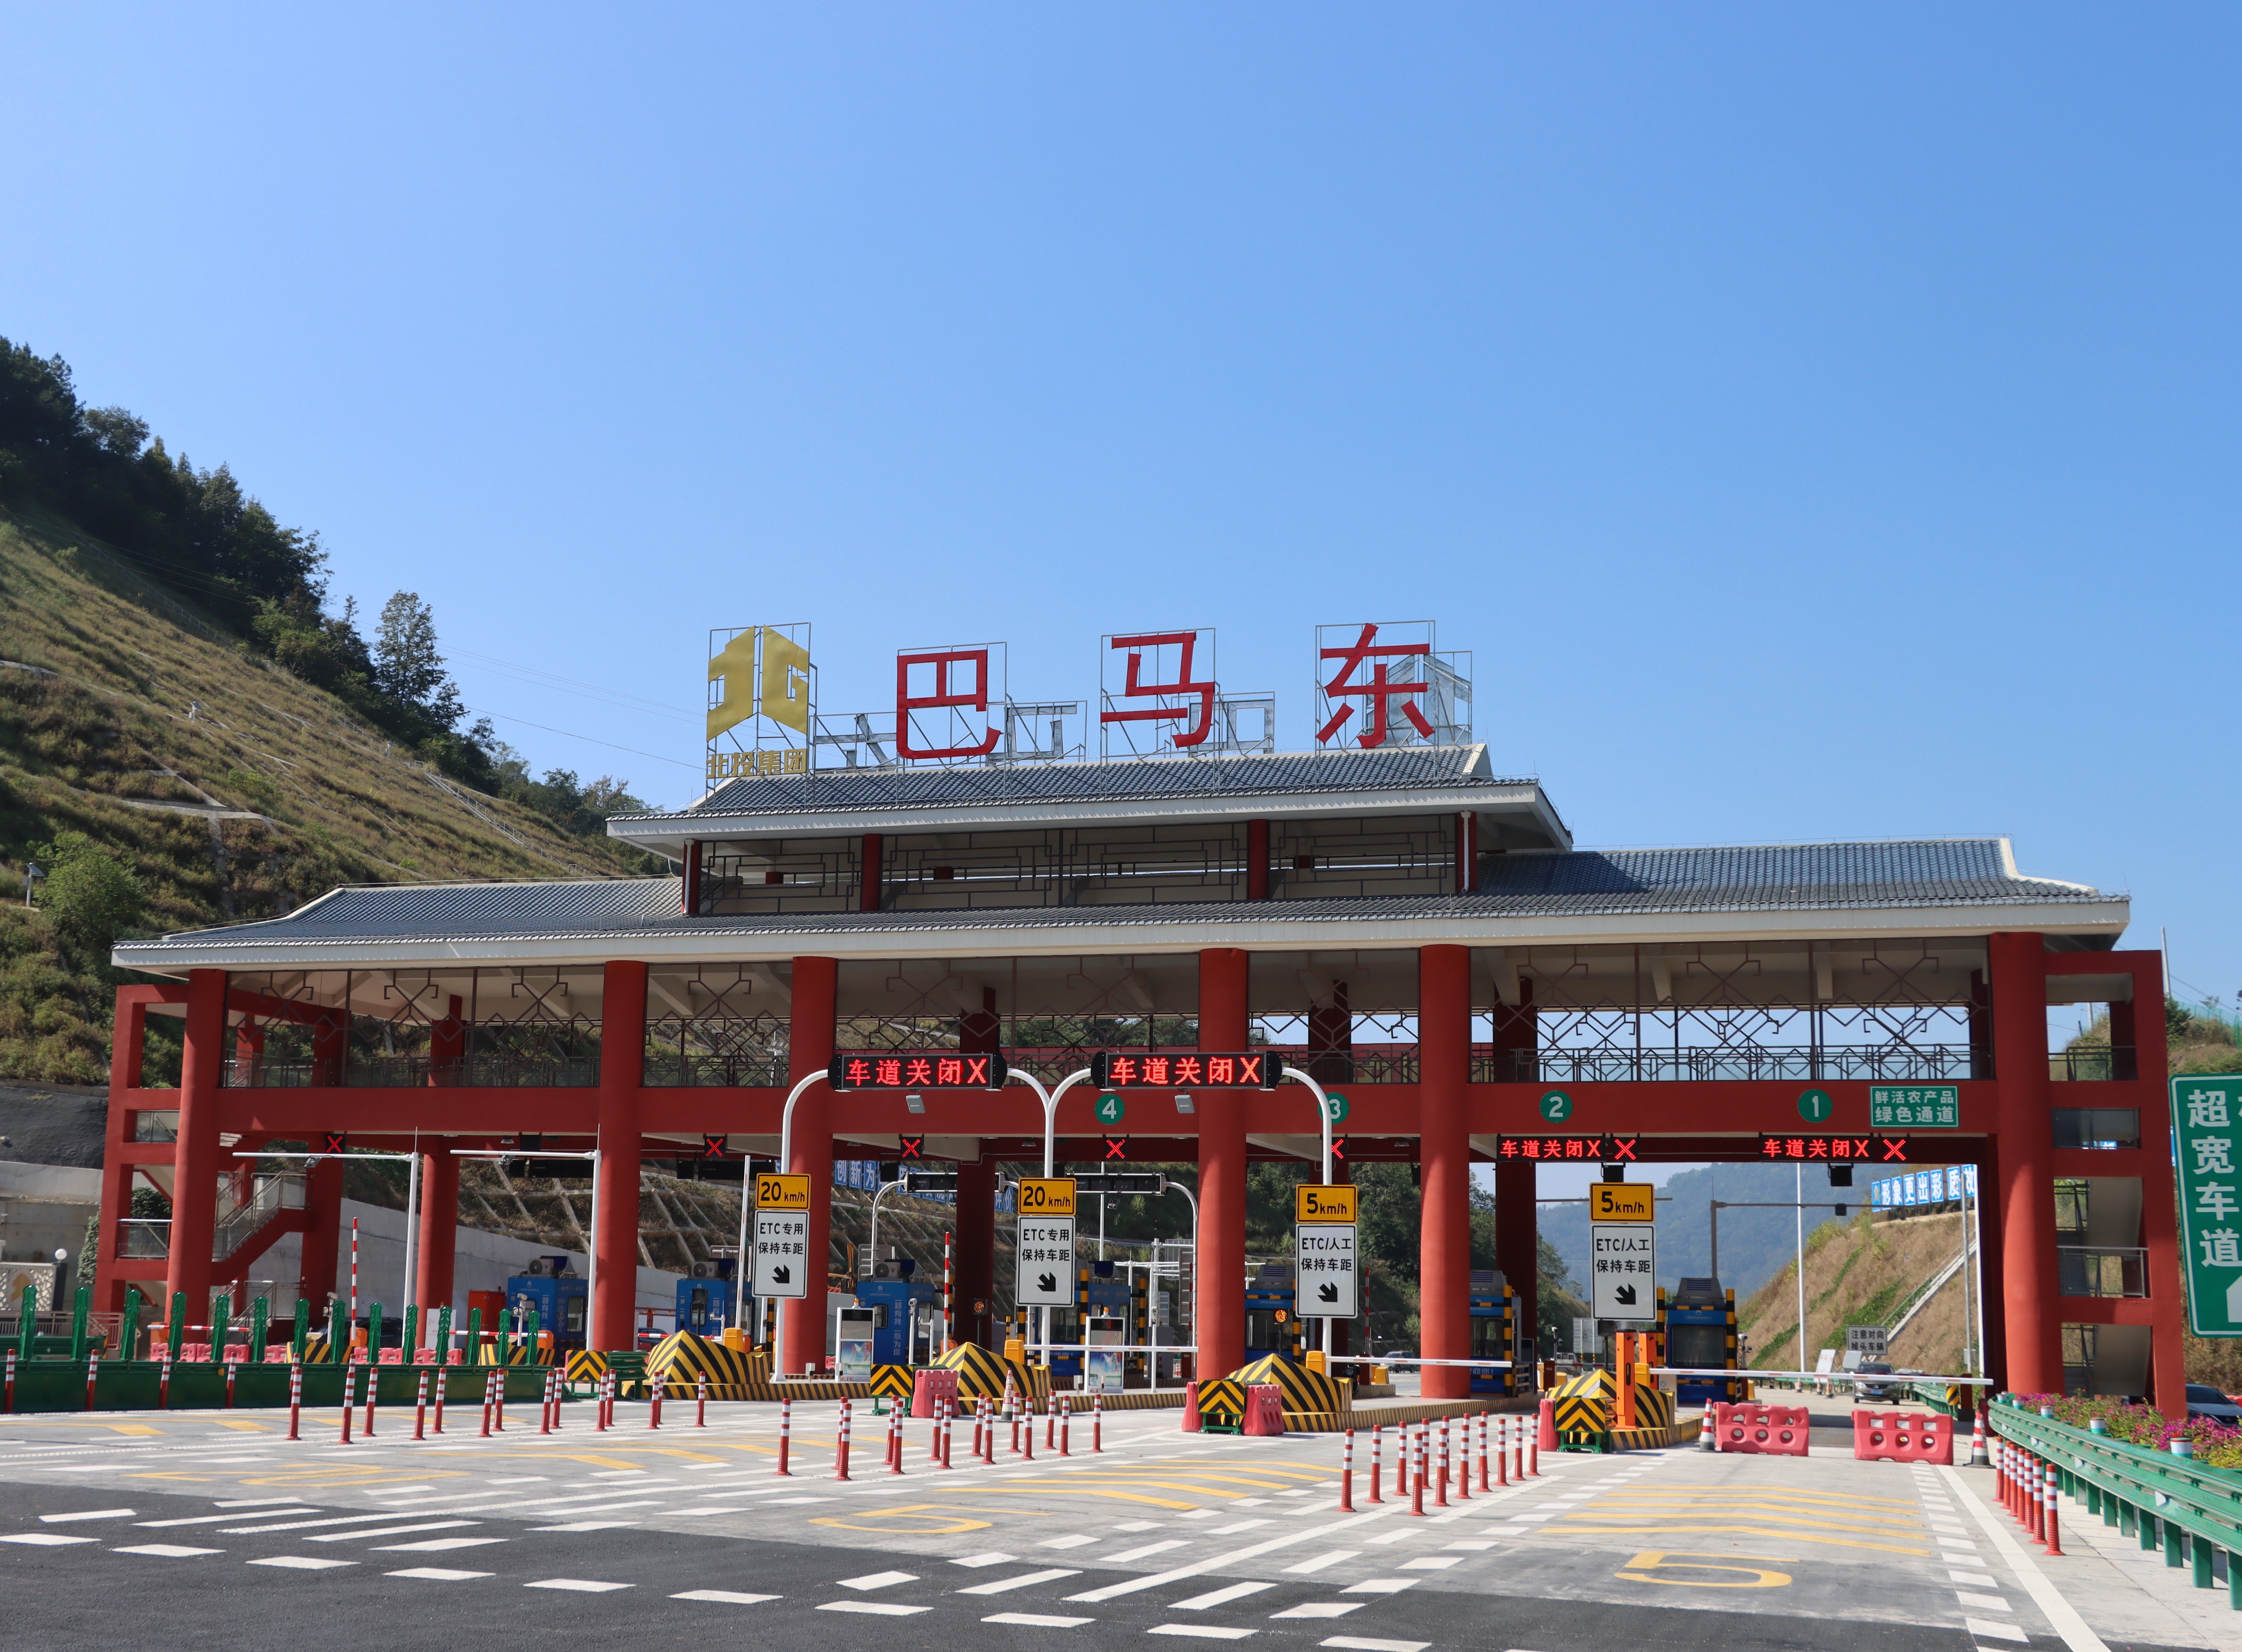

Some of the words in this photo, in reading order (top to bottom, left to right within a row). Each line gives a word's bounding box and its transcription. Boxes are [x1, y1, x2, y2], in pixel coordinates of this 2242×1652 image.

[897, 623, 1435, 760] 巴马东
[706, 748, 807, 778] 北投集团
[1549, 1096, 1564, 1117] 2
[1811, 1095, 1820, 1117] 1
[1875, 1091, 1954, 1104] 鲜活农产品
[1102, 1099, 1117, 1119] 4
[1329, 1098, 1341, 1119] 3
[1875, 1106, 1954, 1123] 绿色通道
[837, 1161, 887, 1190] 创新为
[2187, 1089, 2242, 1267] 超宽车道
[761, 1182, 782, 1202] 20
[784, 1191, 805, 1202] km/h
[1023, 1186, 1045, 1207] 20
[1048, 1196, 1071, 1208] km/h
[1882, 1172, 1943, 1205] 形象更出彩
[758, 1242, 804, 1255] 保持车距
[1021, 1248, 1070, 1262] 保持车距
[1301, 1257, 1352, 1272] 保持车距
[1596, 1259, 1651, 1274] 保持车距
[894, 1299, 902, 1325] 一路有我
[893, 1330, 902, 1356] 一心为你
[1851, 1329, 1884, 1340] 注意对向
[1851, 1342, 1884, 1352] 掉头车辆
[809, 1503, 1054, 1534] 5
[1614, 1550, 1800, 1587] 5
